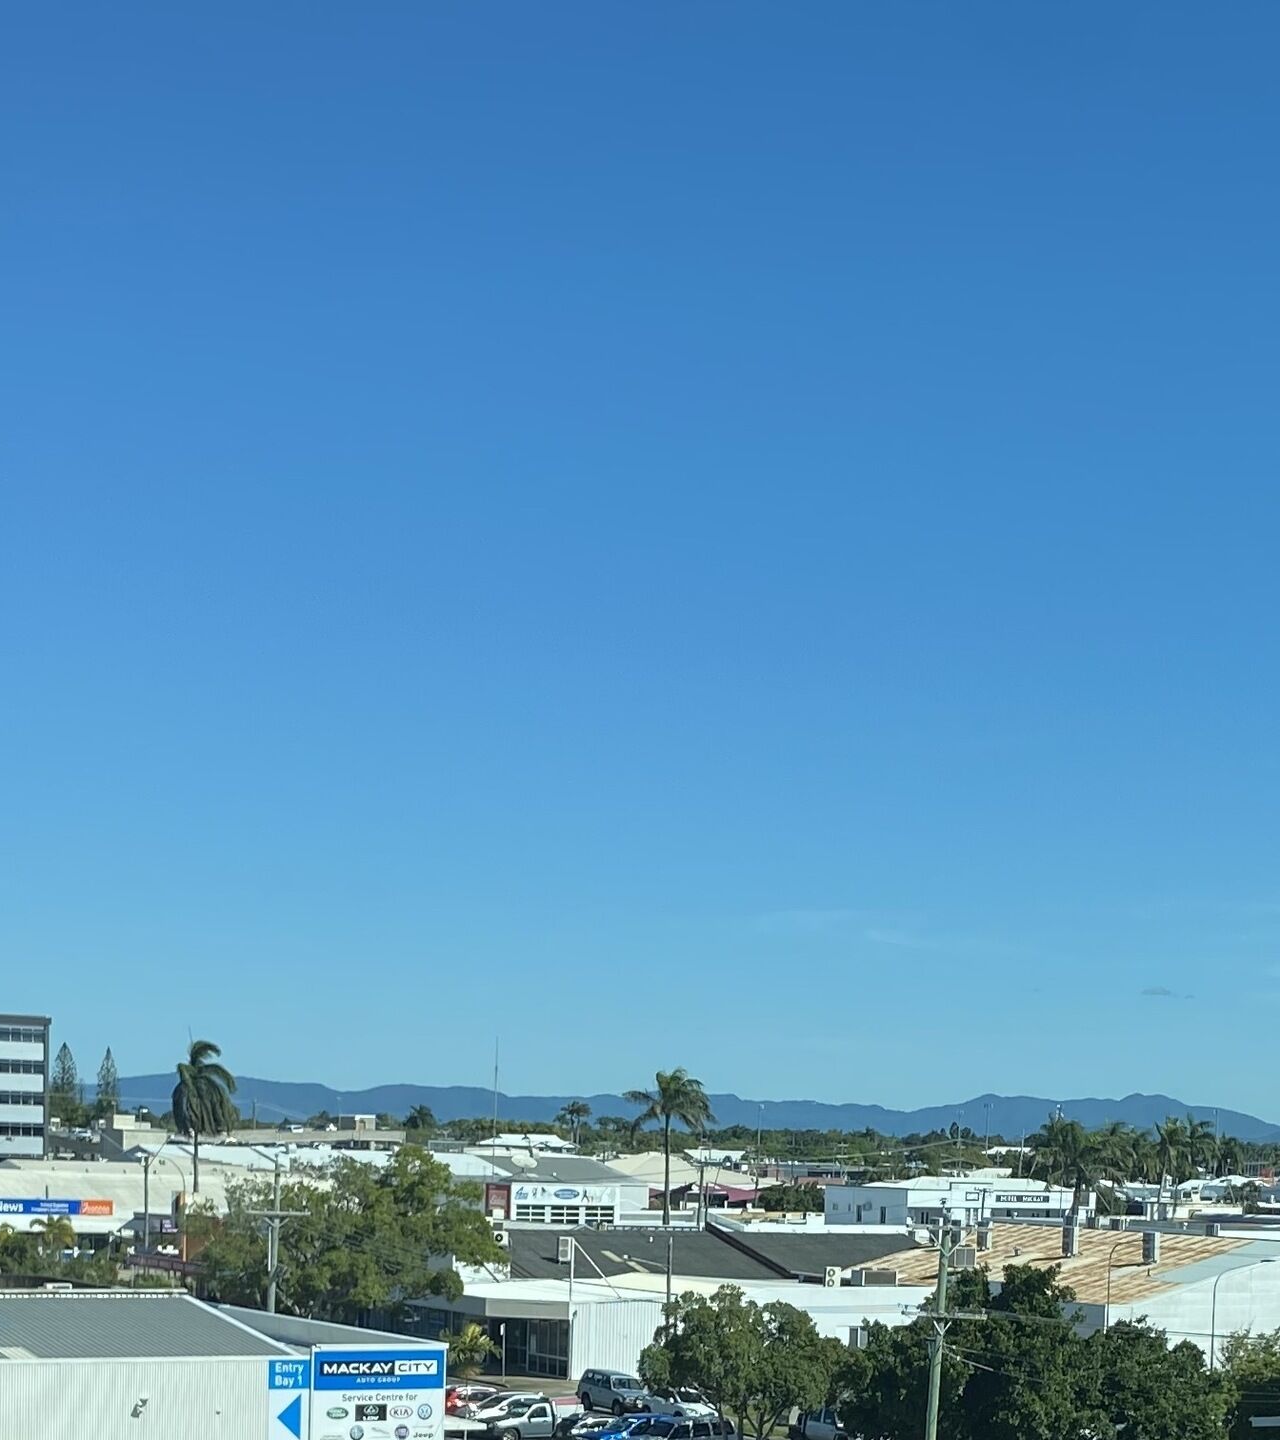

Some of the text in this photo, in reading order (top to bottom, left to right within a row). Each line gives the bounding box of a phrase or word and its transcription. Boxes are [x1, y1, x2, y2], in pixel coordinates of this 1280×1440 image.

[275, 1362, 304, 1374] Entry
[323, 1362, 434, 1375] MACKAY CITY
[275, 1375, 303, 1387] Bay 1
[342, 1393, 418, 1402] Service Centre for
